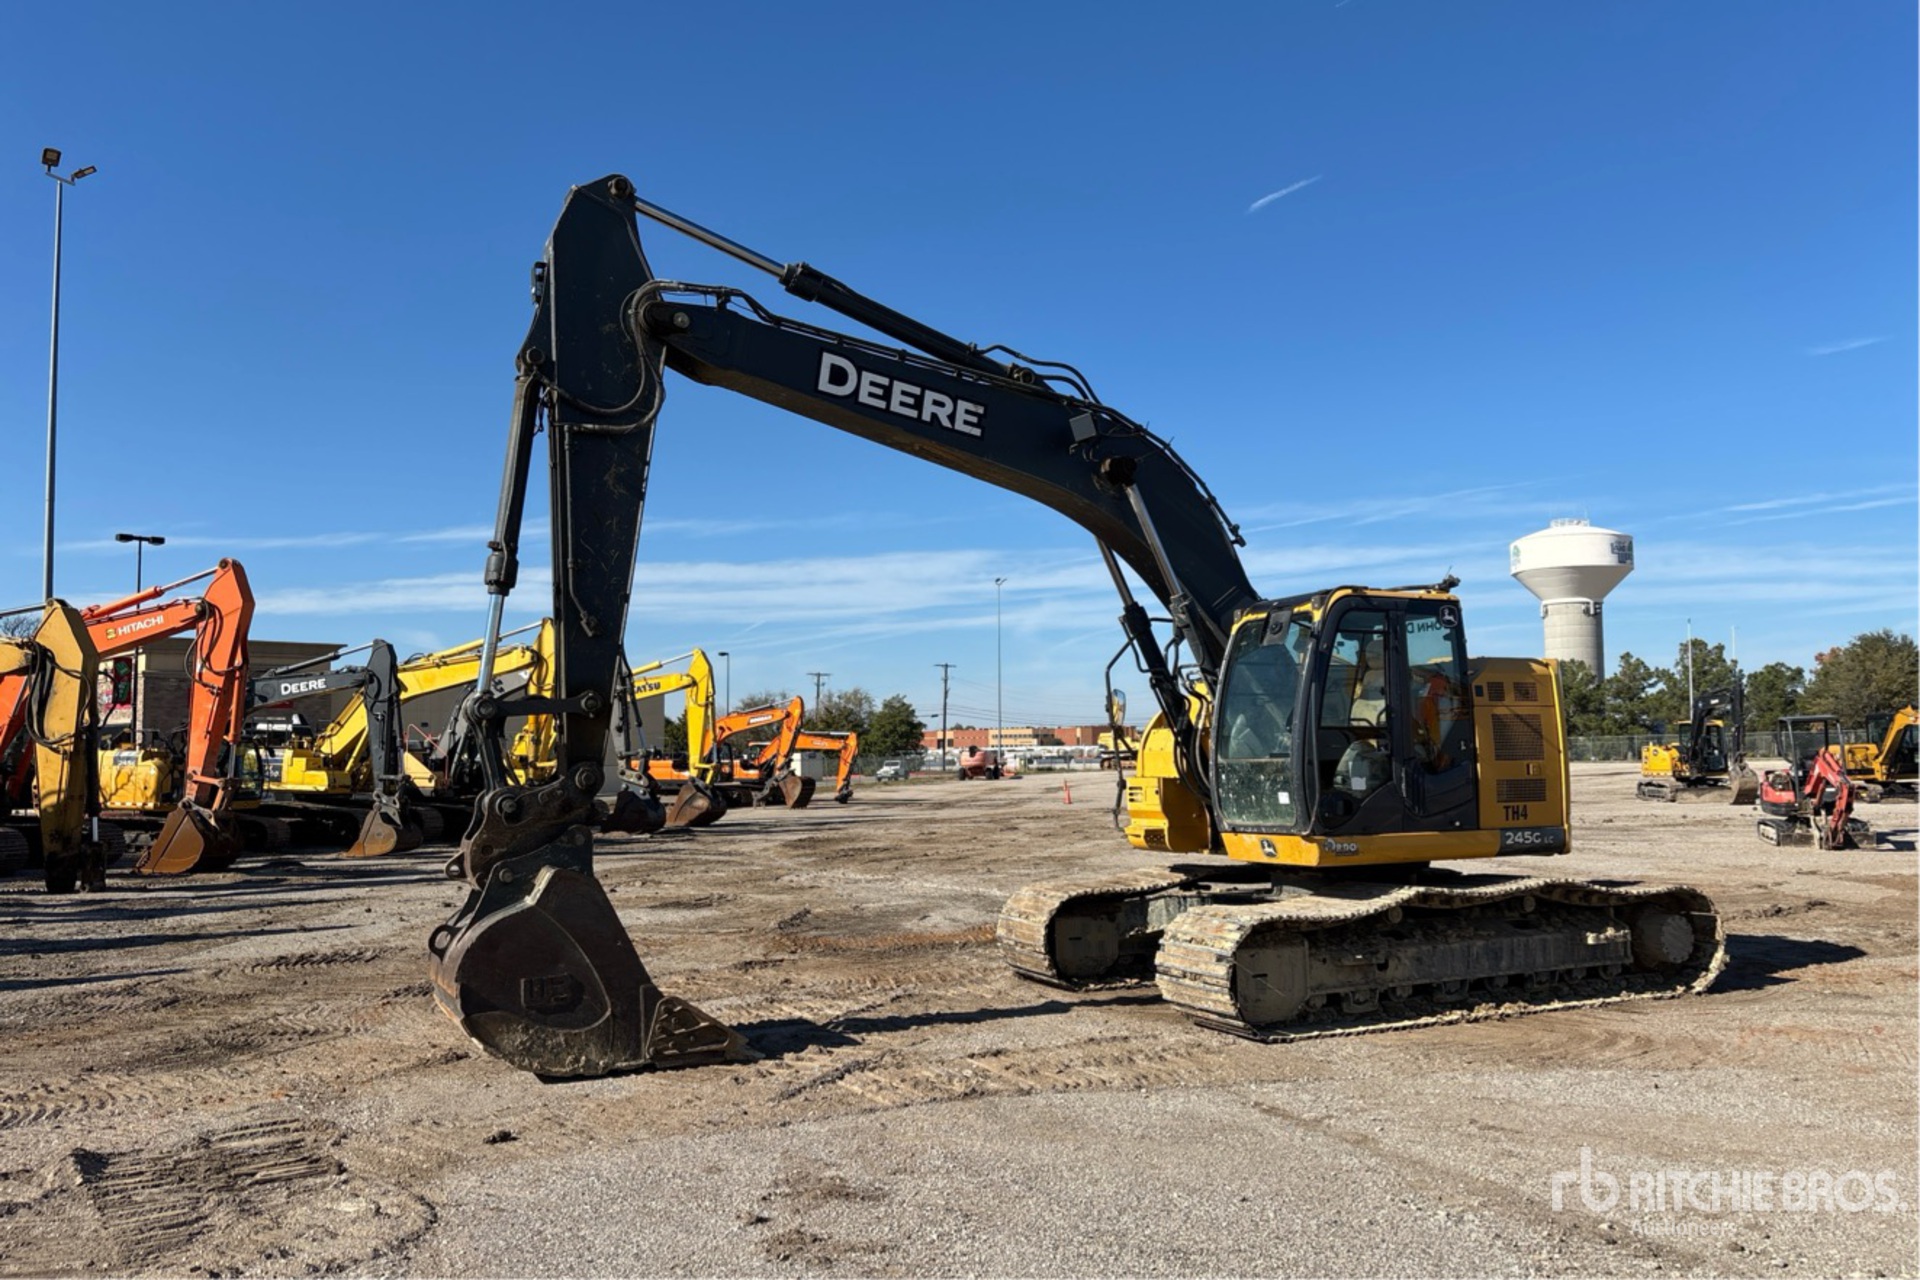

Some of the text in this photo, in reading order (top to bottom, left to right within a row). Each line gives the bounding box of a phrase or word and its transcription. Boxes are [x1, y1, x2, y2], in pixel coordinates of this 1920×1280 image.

[817, 351, 985, 437] DEERE
[118, 614, 164, 636] HITACHI
[281, 678, 327, 695] DEERE
[635, 681, 661, 694] ATSU
[1503, 804, 1528, 821] TH4
[1505, 831, 1541, 845] 245G
